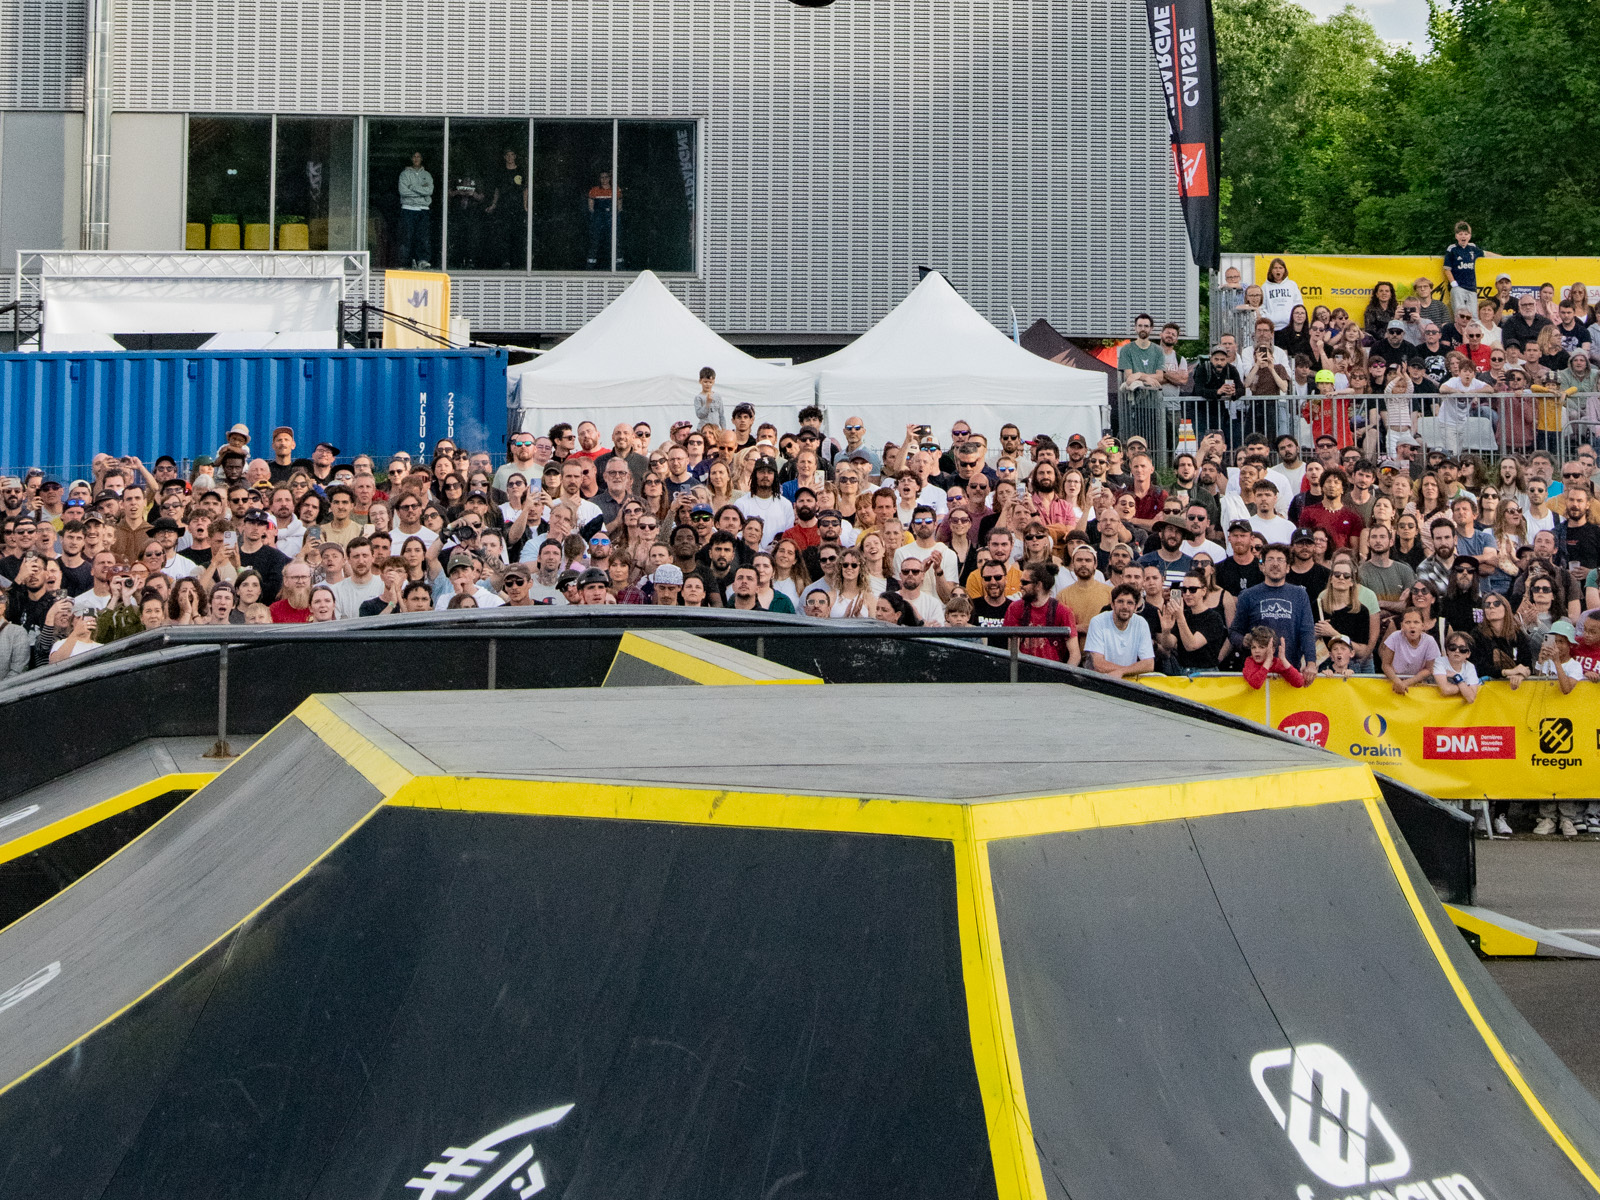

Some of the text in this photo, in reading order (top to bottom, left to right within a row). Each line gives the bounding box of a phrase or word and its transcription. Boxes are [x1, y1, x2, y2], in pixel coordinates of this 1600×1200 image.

[447, 391, 455, 438] 22GD
[1261, 611, 1292, 620] patagonia
[1284, 722, 1322, 742] TOP
[1349, 743, 1402, 758] Orakin
[1436, 734, 1479, 753] DNA
[1531, 753, 1583, 770] freegun
